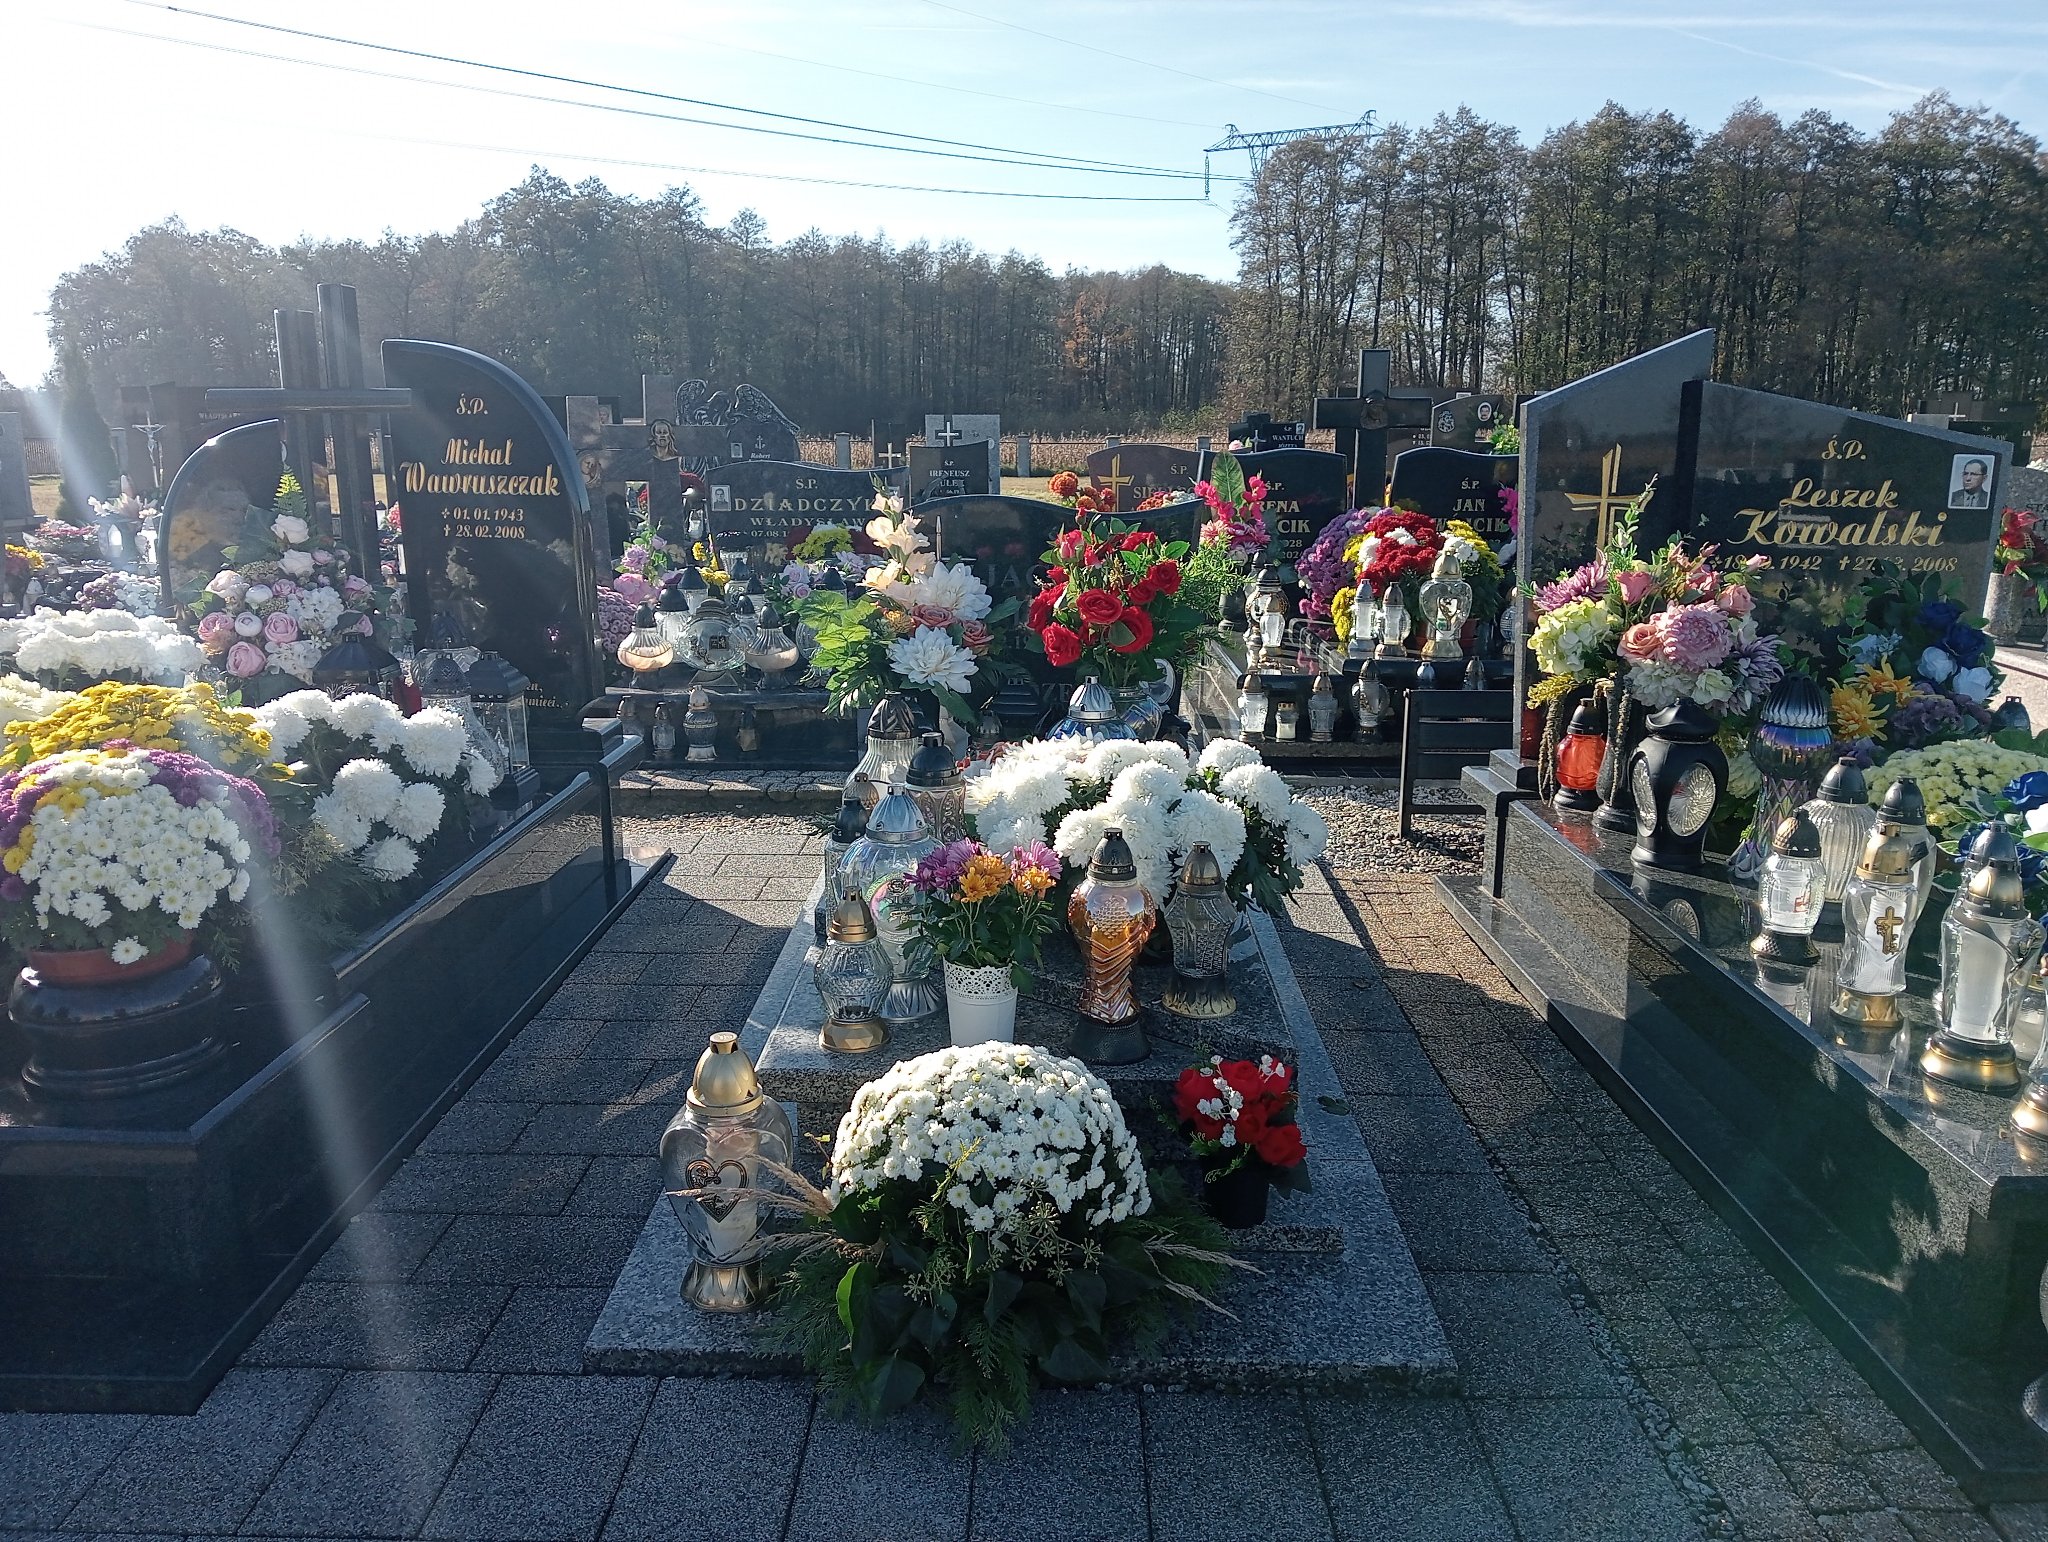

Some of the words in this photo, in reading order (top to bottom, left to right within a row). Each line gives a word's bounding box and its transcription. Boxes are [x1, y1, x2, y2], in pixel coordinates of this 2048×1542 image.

[441, 438, 514, 466] Michał
[1821, 435, 1867, 461] Ś.P.
[399, 461, 561, 496] Wawruszczak
[1779, 477, 1899, 509] Leszek
[1453, 499, 1486, 512] JAN
[1726, 510, 1948, 547] Kowalski
